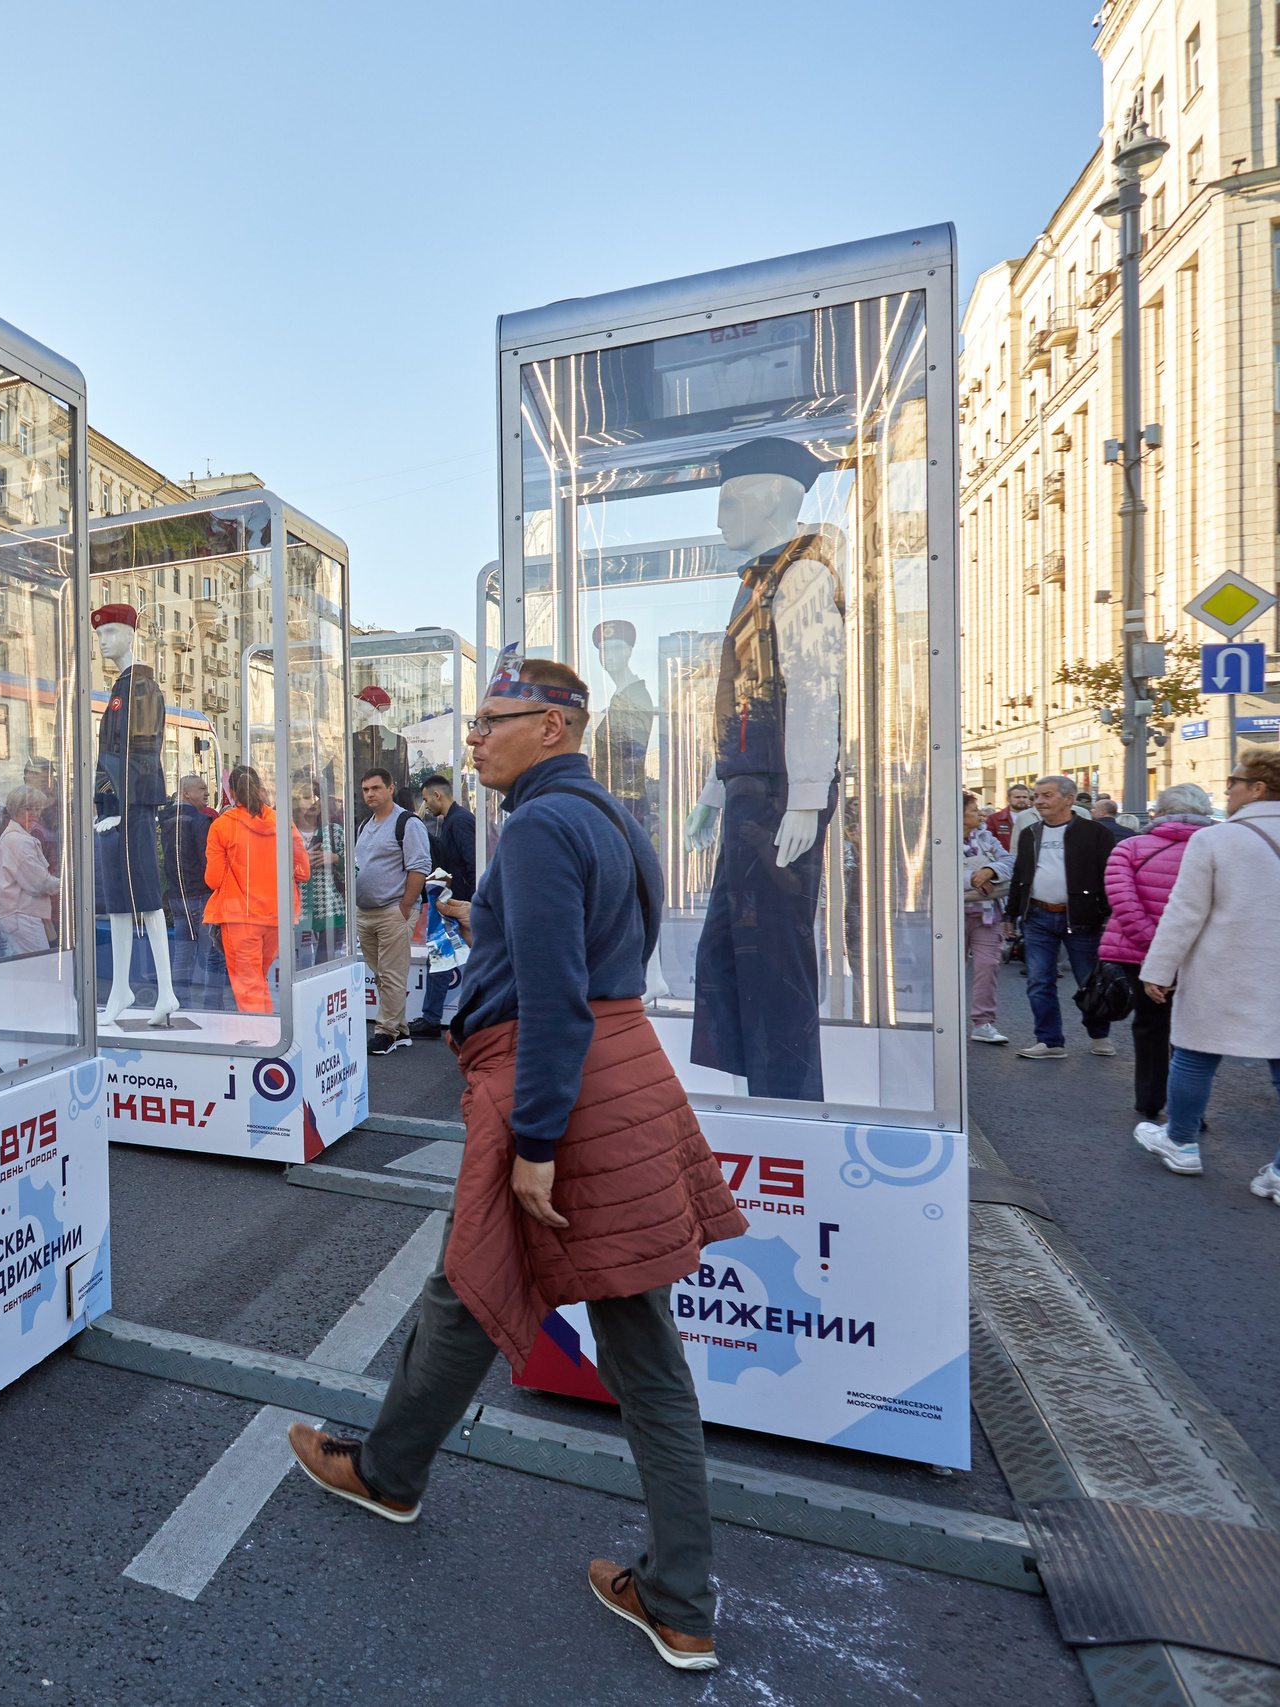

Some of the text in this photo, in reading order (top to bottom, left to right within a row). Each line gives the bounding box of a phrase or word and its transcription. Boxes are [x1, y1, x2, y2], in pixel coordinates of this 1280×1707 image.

[327, 988, 347, 1016] 875
[315, 1053, 341, 1079] МОСКВА
[321, 1061, 358, 1095] В ДВИЖЕНИИ
[123, 1074, 178, 1091] города,
[107, 1092, 217, 1128] КВА!
[0, 1109, 57, 1167] 875
[0, 1147, 58, 1184] ДЕНЬ ГОРОДА
[711, 1151, 804, 1198] 75
[735, 1198, 805, 1216] ОРОДА
[3, 1282, 43, 1314] СЕНТЯБРЯ
[669, 1293, 876, 1348] ВИЖЕНИИ
[678, 1330, 758, 1352] ЕНТЯБРЯ
[846, 1390, 943, 1412] #МОСКОВСКИЕСЕЗОНЫ
[846, 1398, 942, 1421] MOSCOWSEASONS.COM
